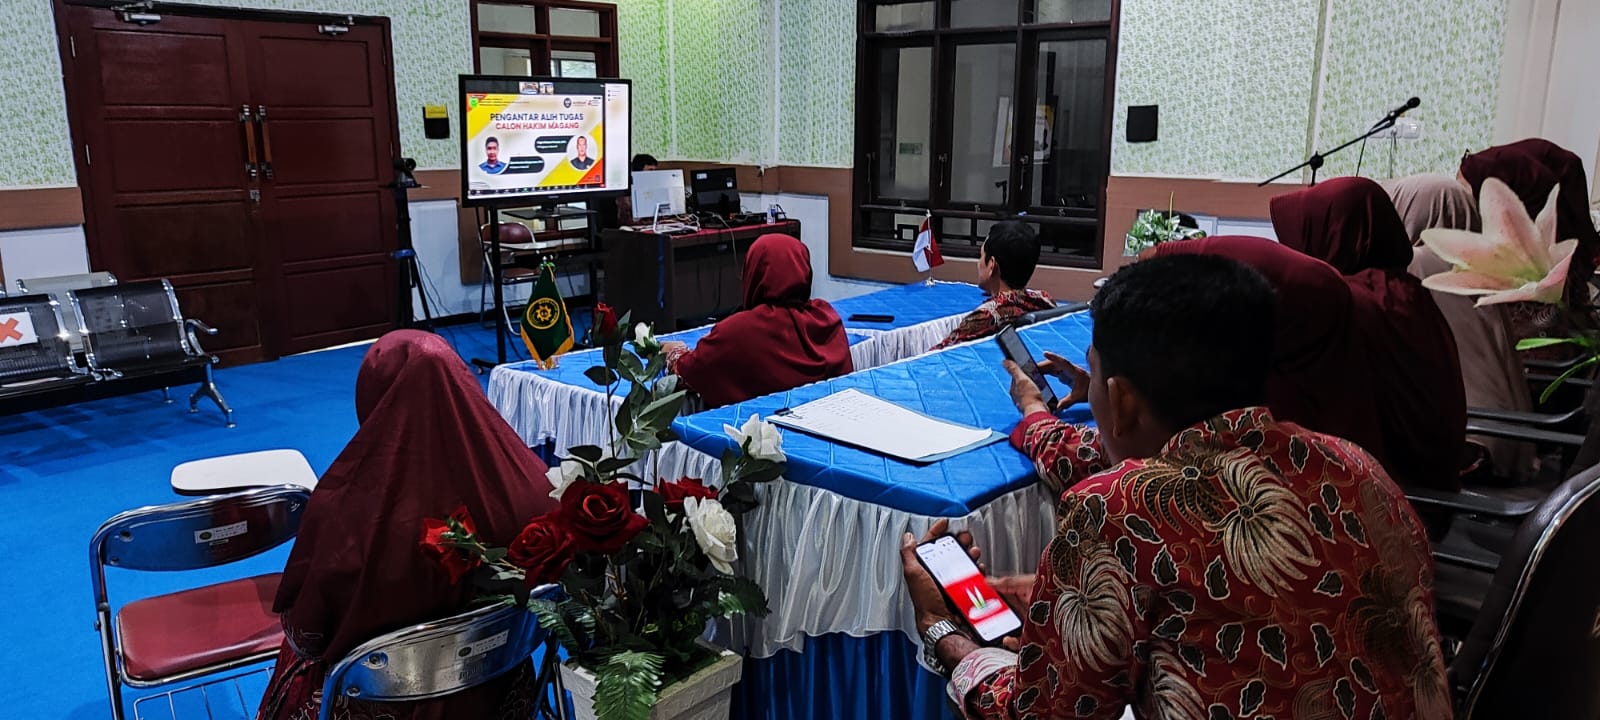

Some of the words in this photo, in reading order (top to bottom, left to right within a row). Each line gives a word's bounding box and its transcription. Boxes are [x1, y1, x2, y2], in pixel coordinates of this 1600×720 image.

[490, 113, 539, 121] PENGANTAR
[540, 113, 558, 121] ALIH
[559, 113, 584, 121] TUGAS
[495, 122, 521, 130] CALON
[523, 122, 547, 130] HAKIM
